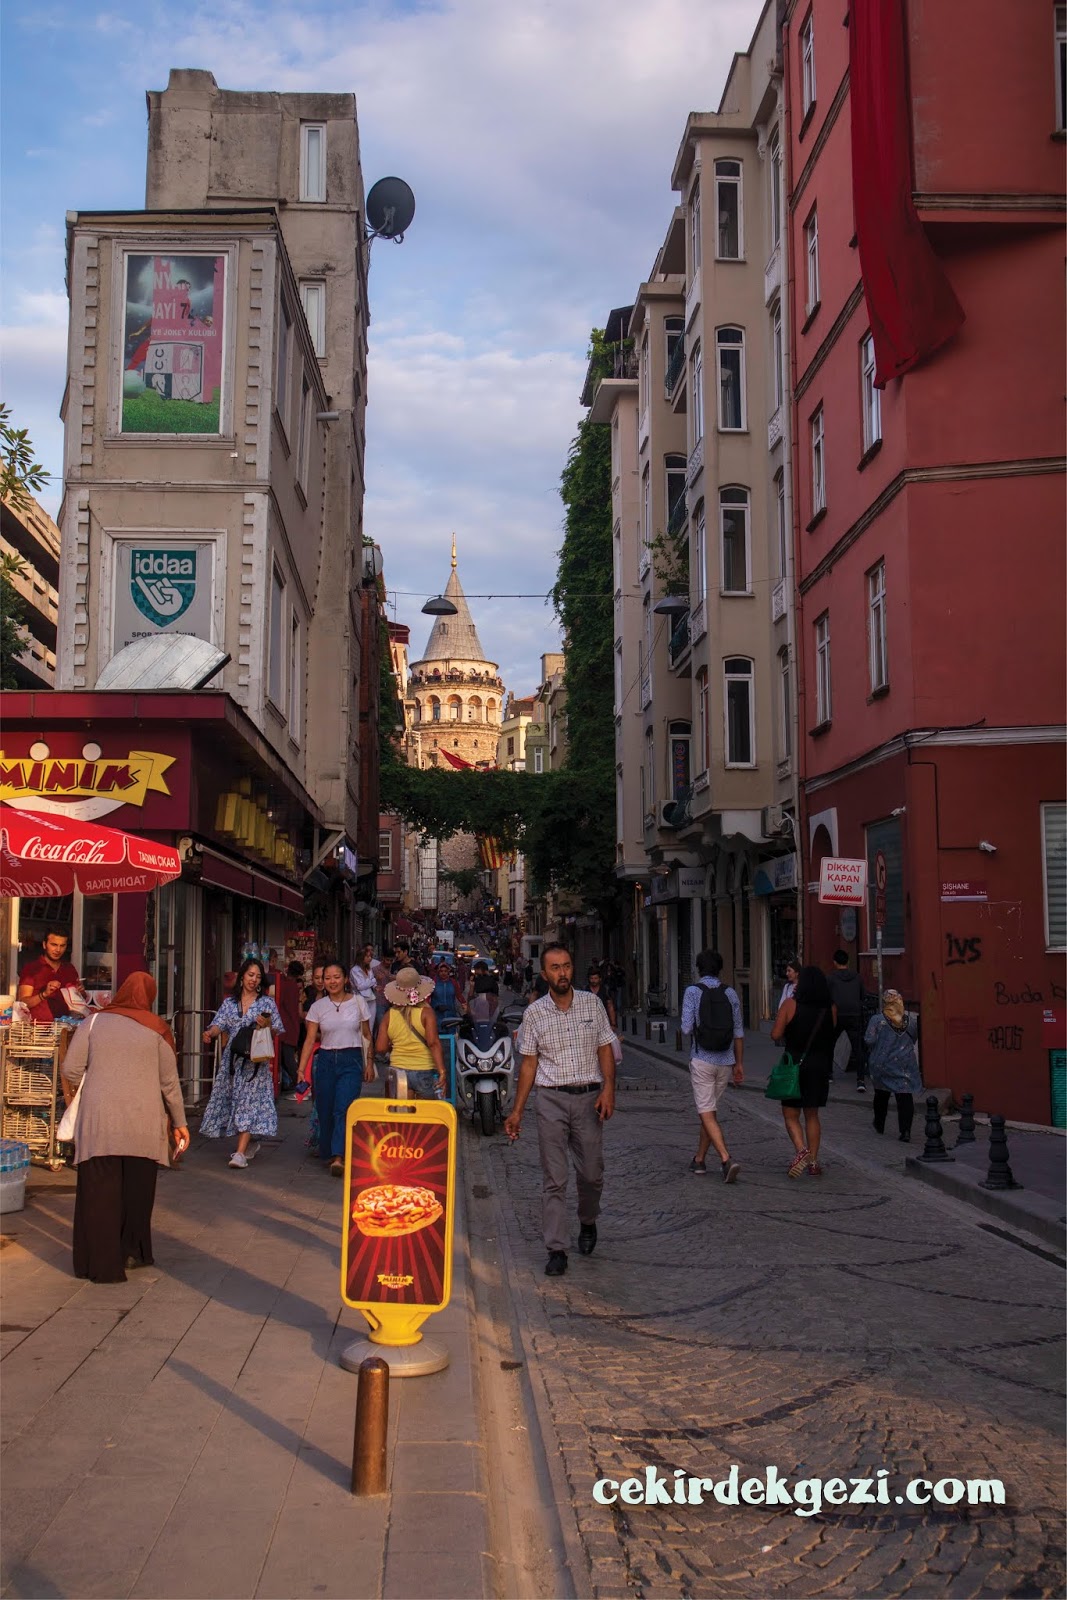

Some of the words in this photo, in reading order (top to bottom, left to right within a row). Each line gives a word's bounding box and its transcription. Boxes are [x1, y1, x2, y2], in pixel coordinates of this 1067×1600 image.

[135, 553, 193, 575] iddaa
[21, 836, 109, 863] Coca-Cola
[138, 851, 158, 864] TADINI
[158, 856, 177, 868] ÇIKAR
[827, 863, 862, 872] DİKKAT
[827, 874, 860, 883] KAPAN
[833, 885, 853, 893] VAR
[377, 1144, 424, 1160] Patso
